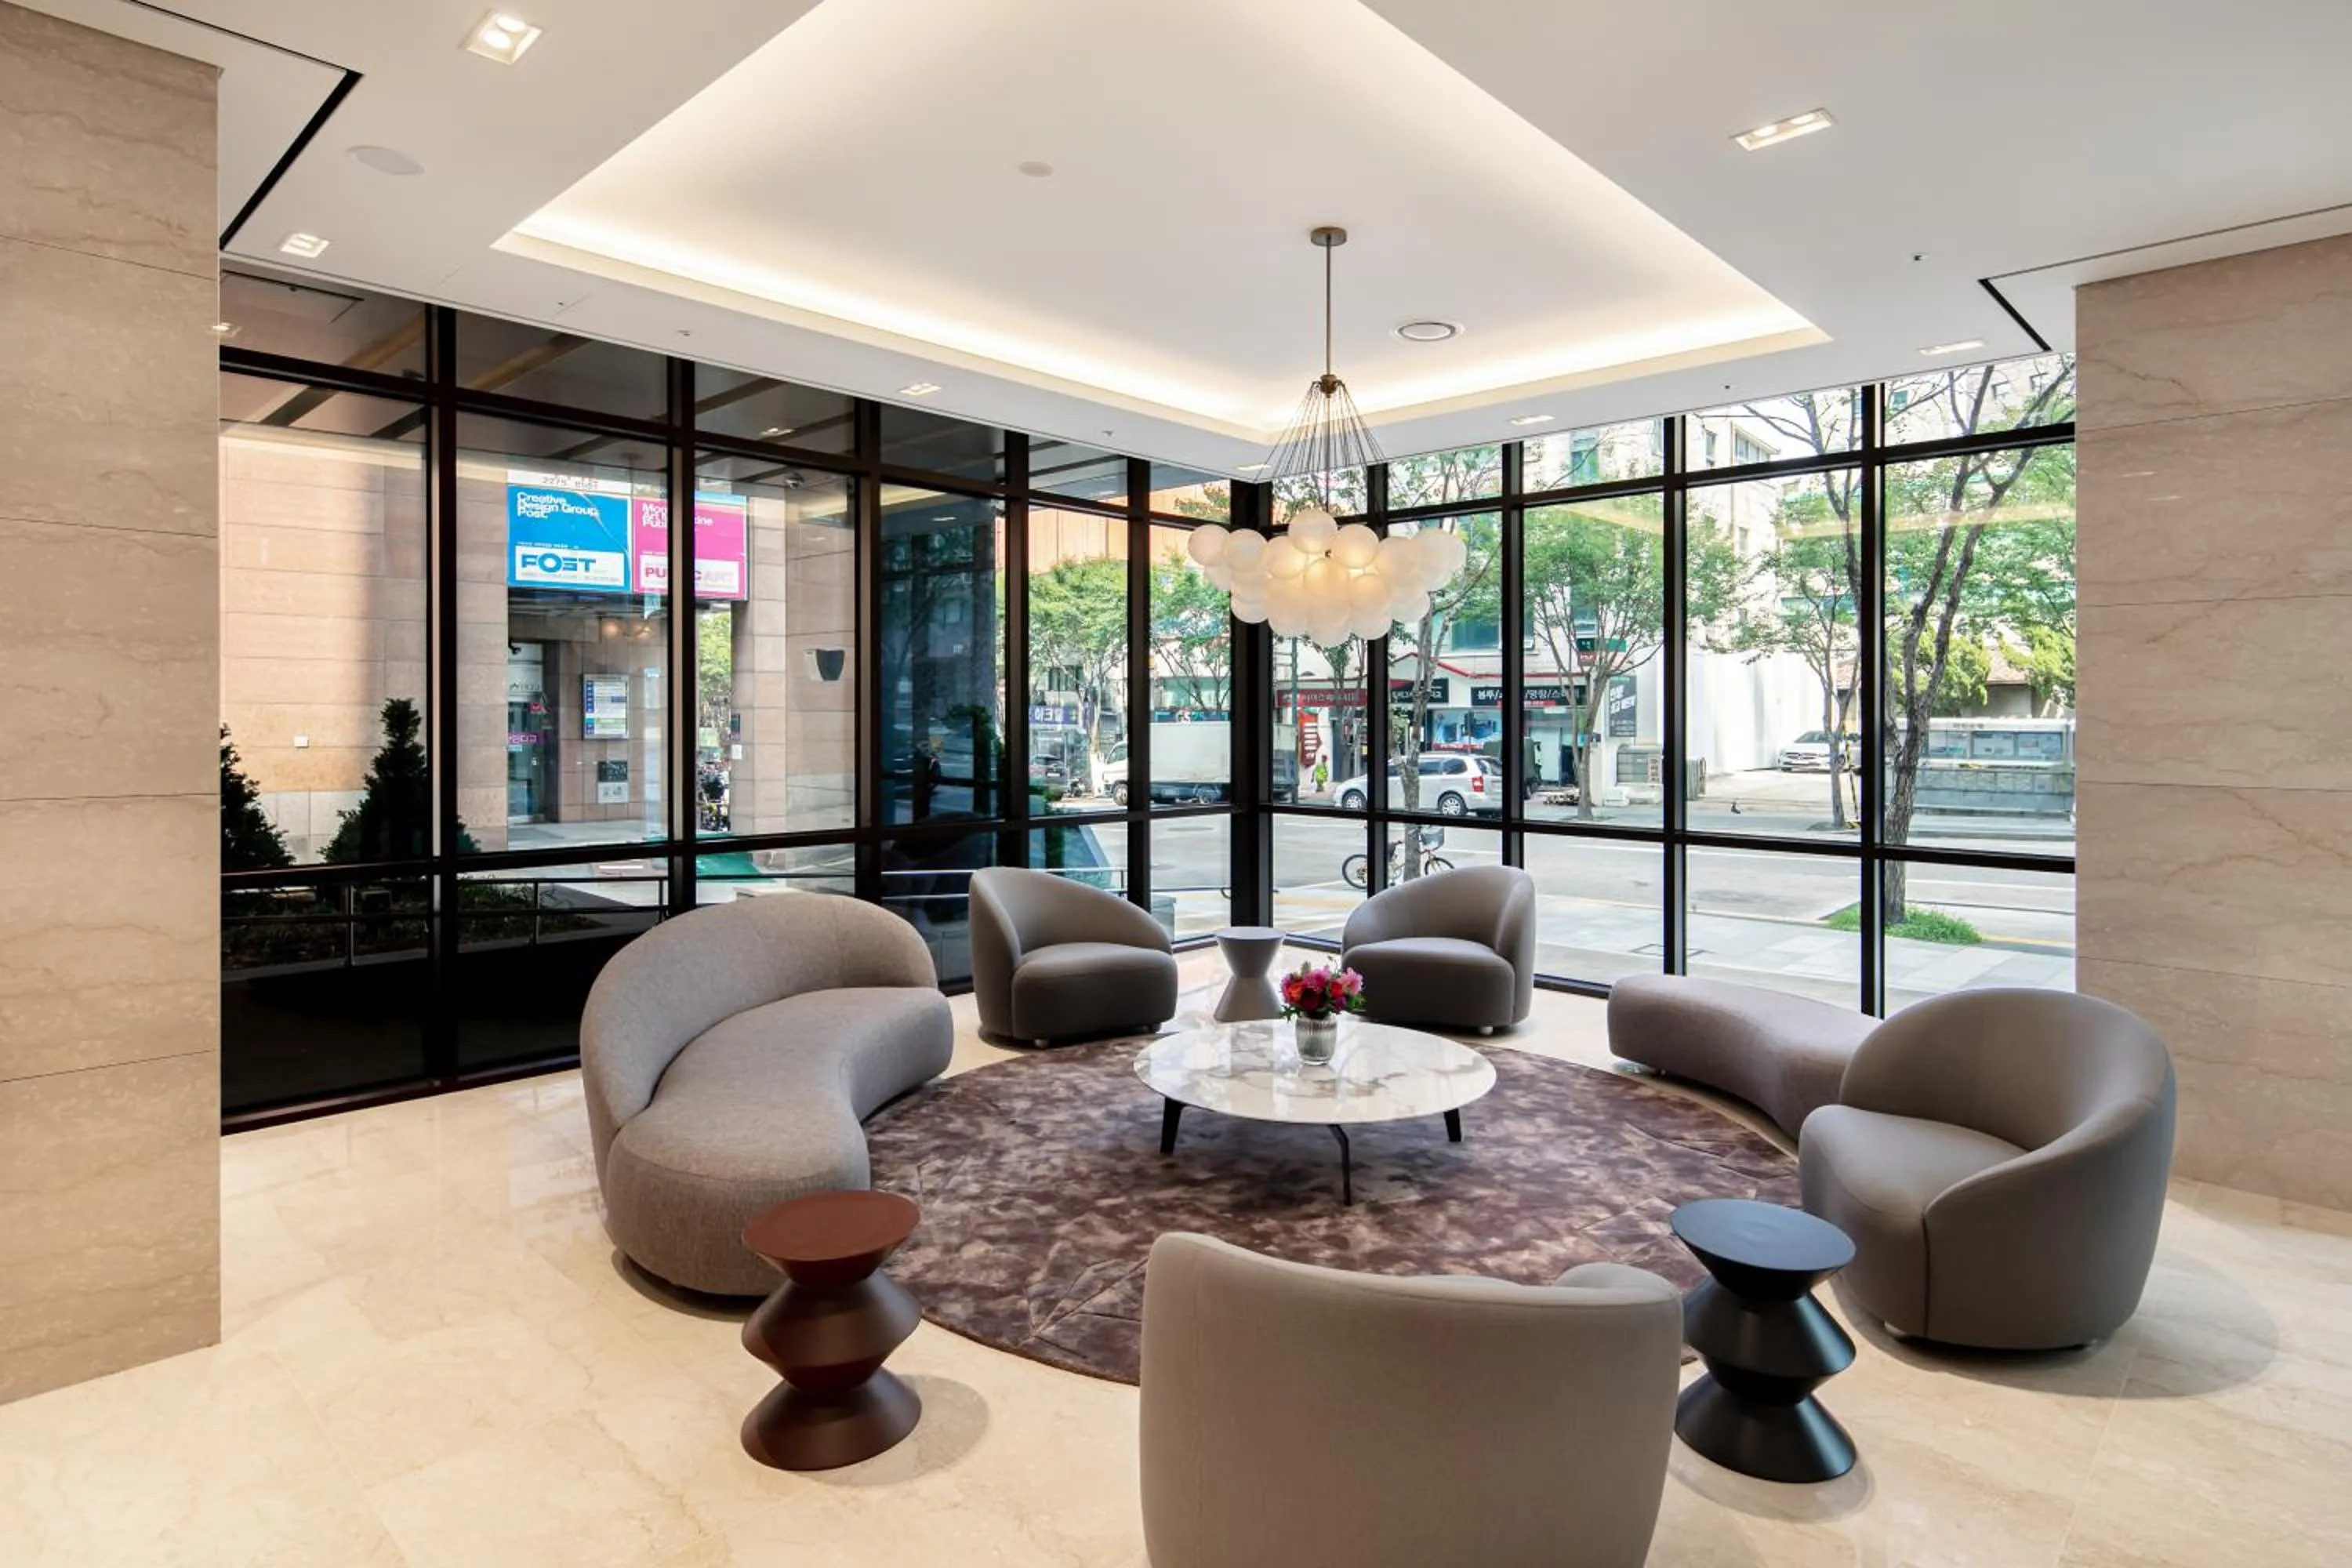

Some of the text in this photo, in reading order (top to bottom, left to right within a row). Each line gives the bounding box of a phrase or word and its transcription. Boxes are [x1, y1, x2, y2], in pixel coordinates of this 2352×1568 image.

[517, 492, 567, 504] Creative
[517, 499, 599, 518] Design Group
